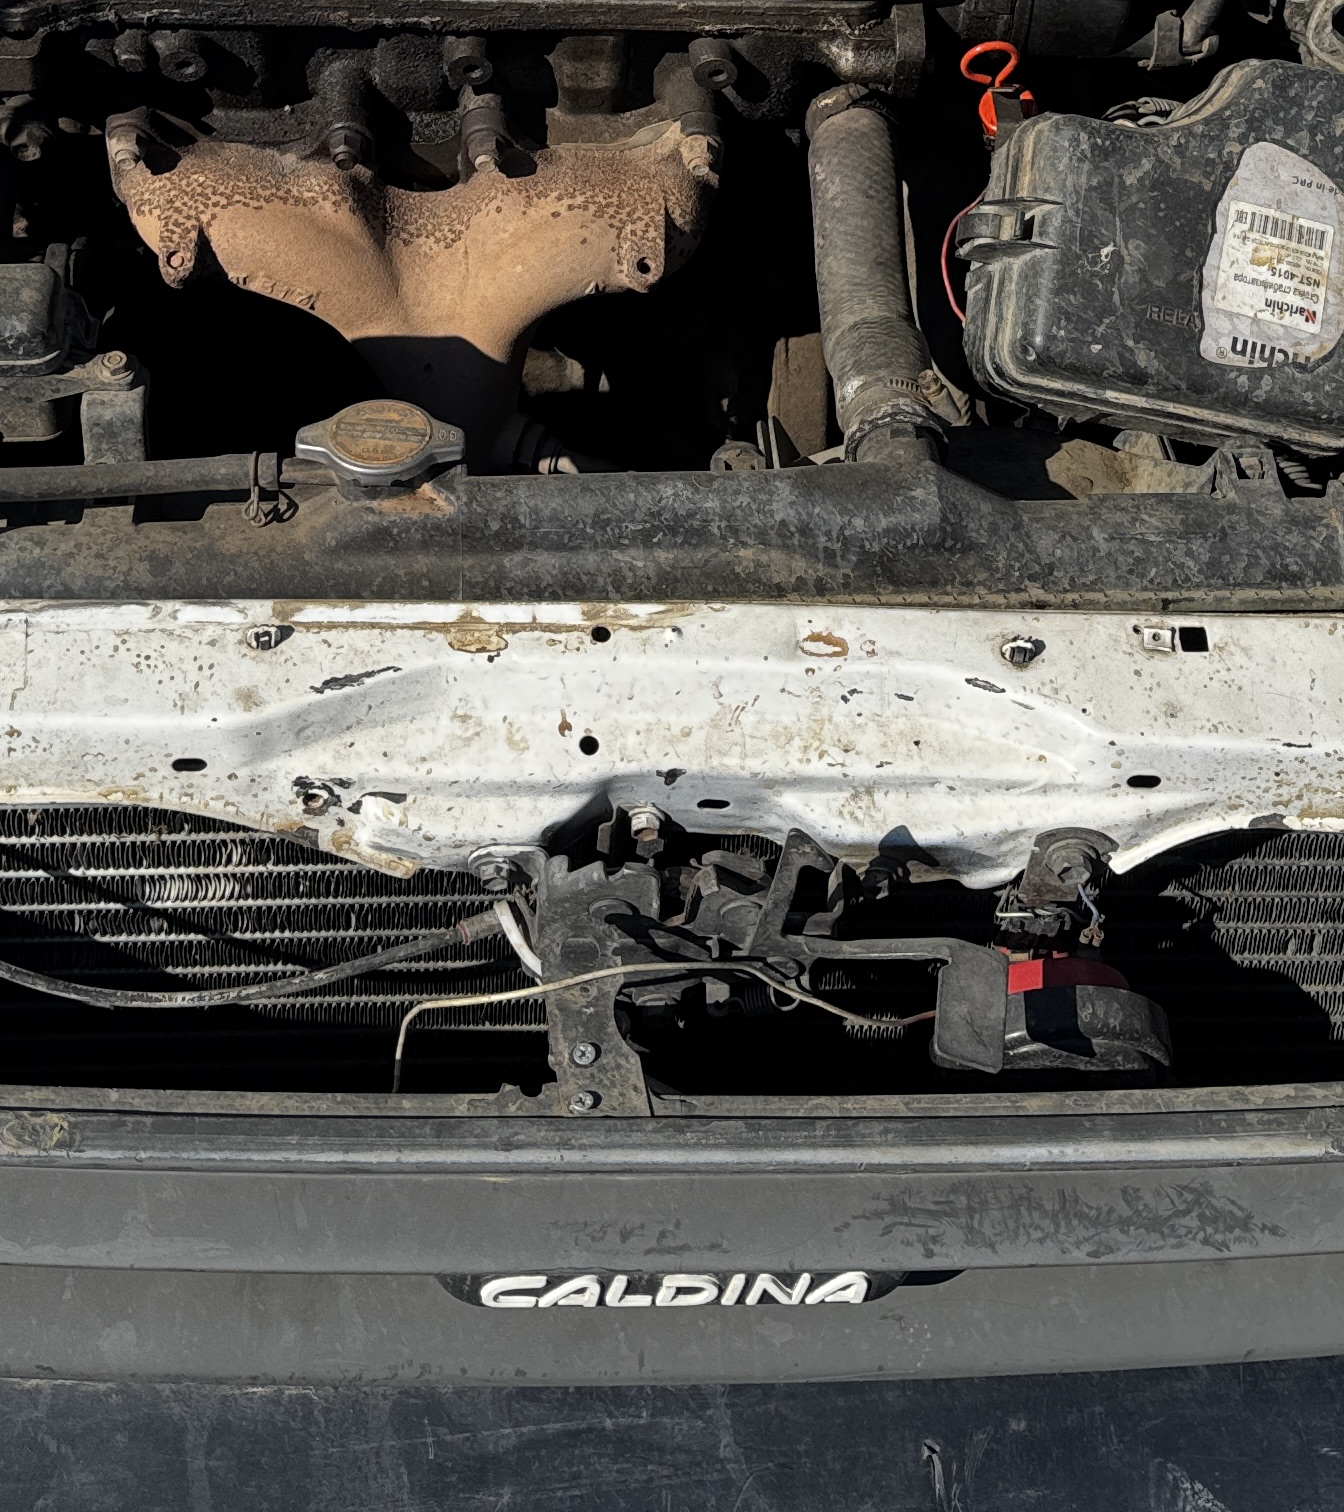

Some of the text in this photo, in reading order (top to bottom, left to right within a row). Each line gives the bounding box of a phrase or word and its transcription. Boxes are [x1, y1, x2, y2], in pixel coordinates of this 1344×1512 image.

[1291, 175, 1313, 188] PRC
[1146, 304, 1199, 329] RELA
[480, 1271, 869, 1309] CALDINA
